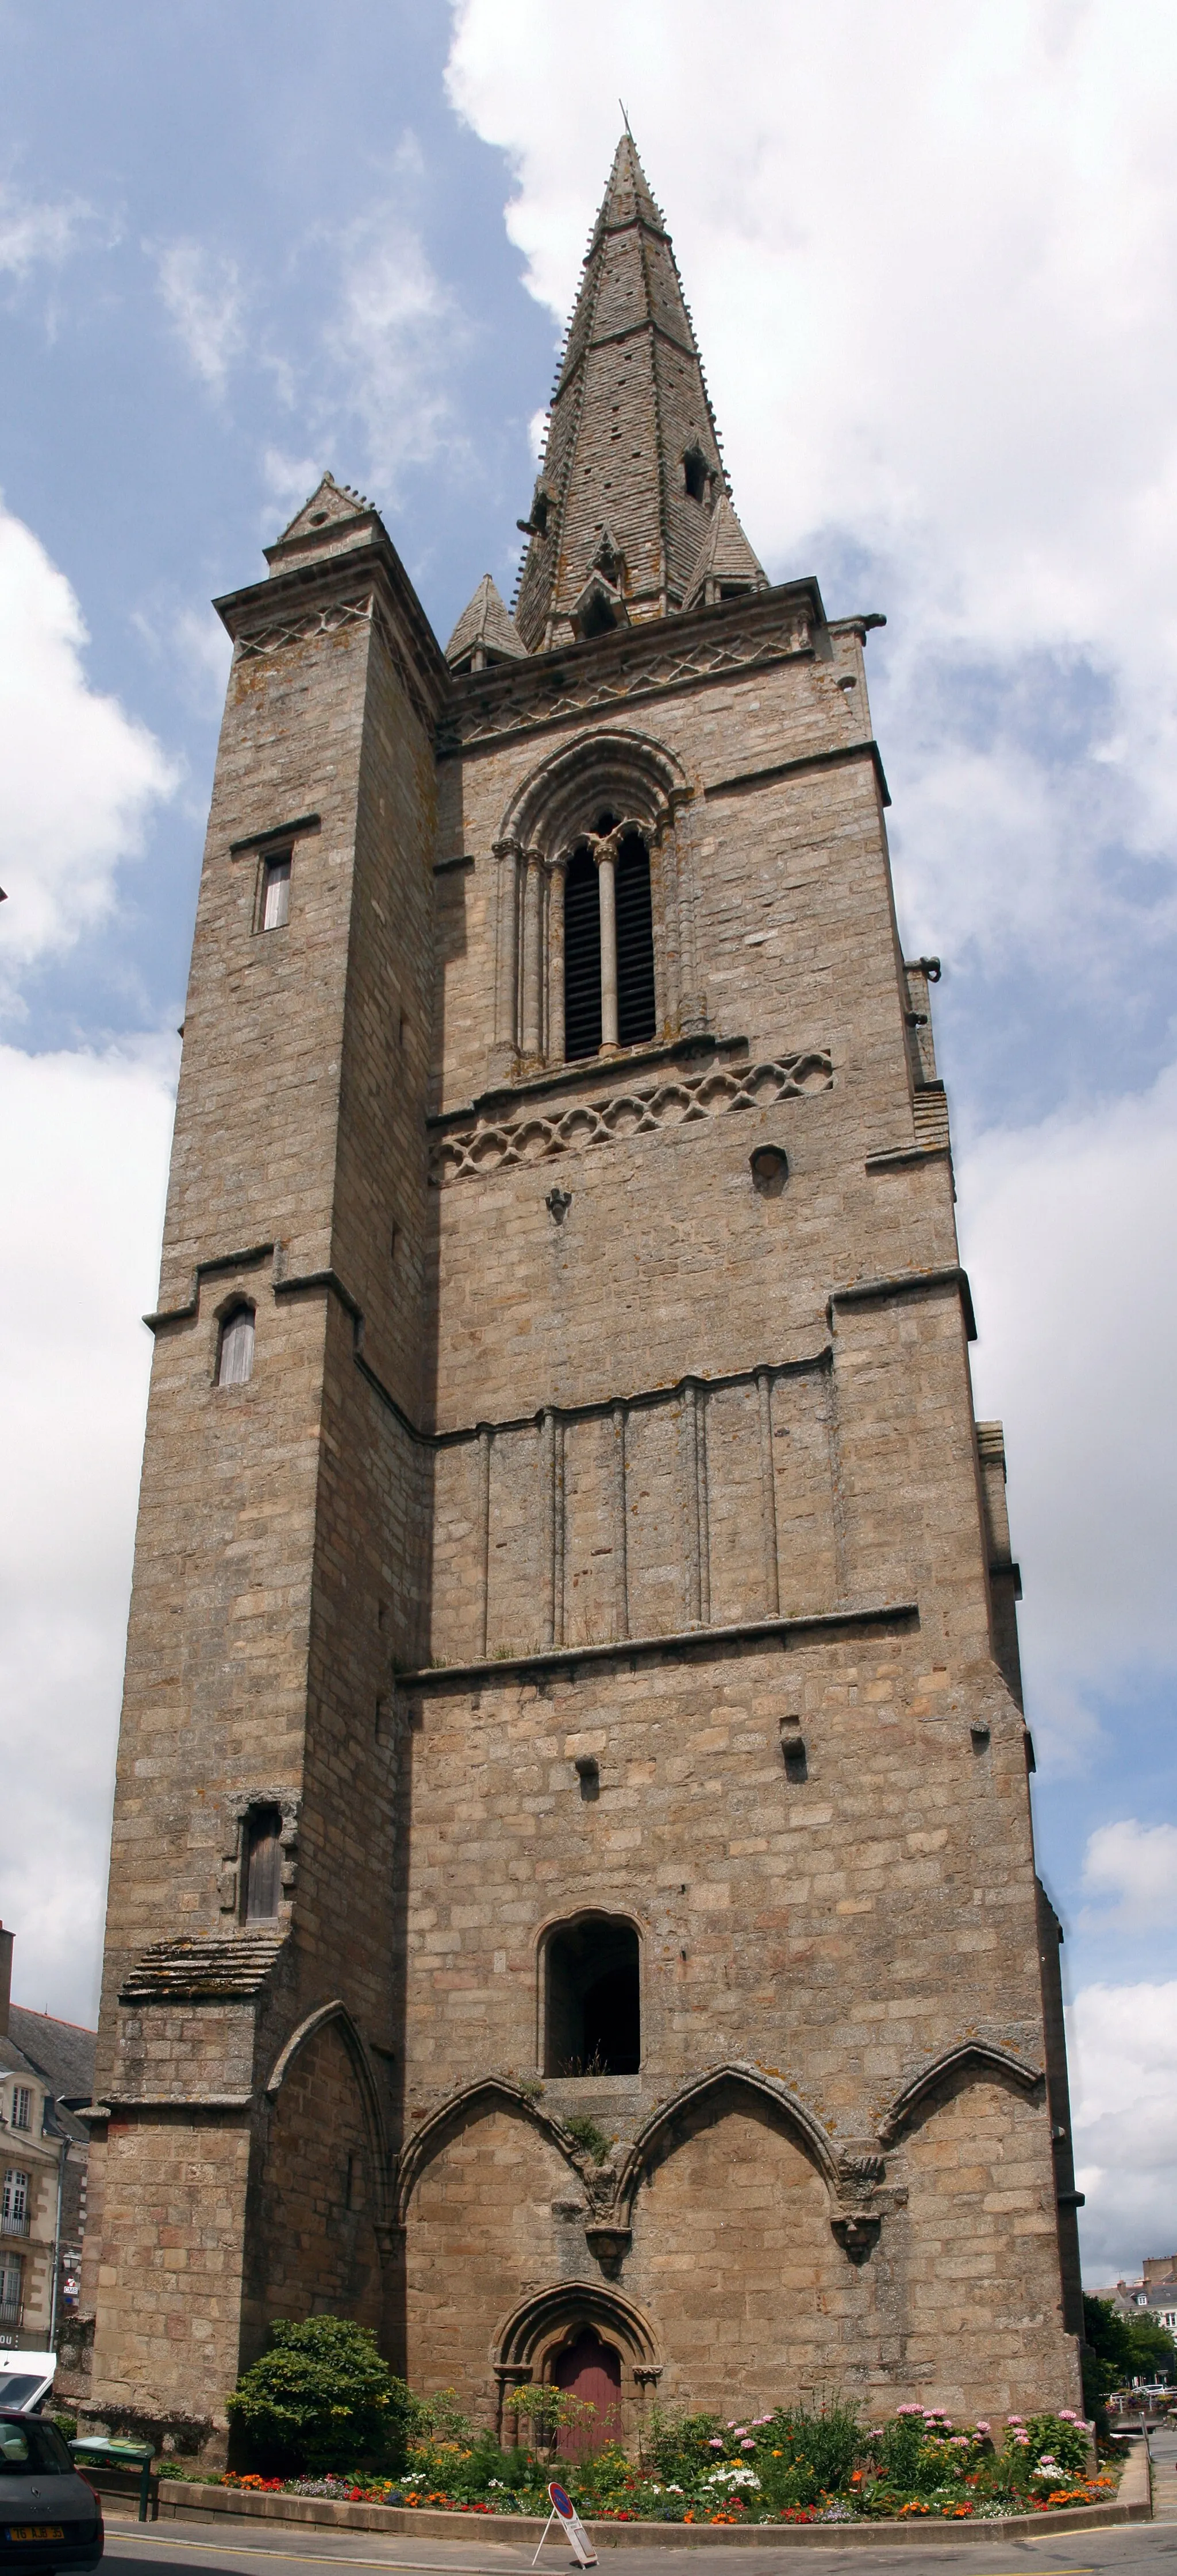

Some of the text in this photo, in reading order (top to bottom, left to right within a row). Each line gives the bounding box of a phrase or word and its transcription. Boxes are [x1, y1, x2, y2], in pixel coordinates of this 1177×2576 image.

[13, 2528, 62, 2539] 76 AJB 35
